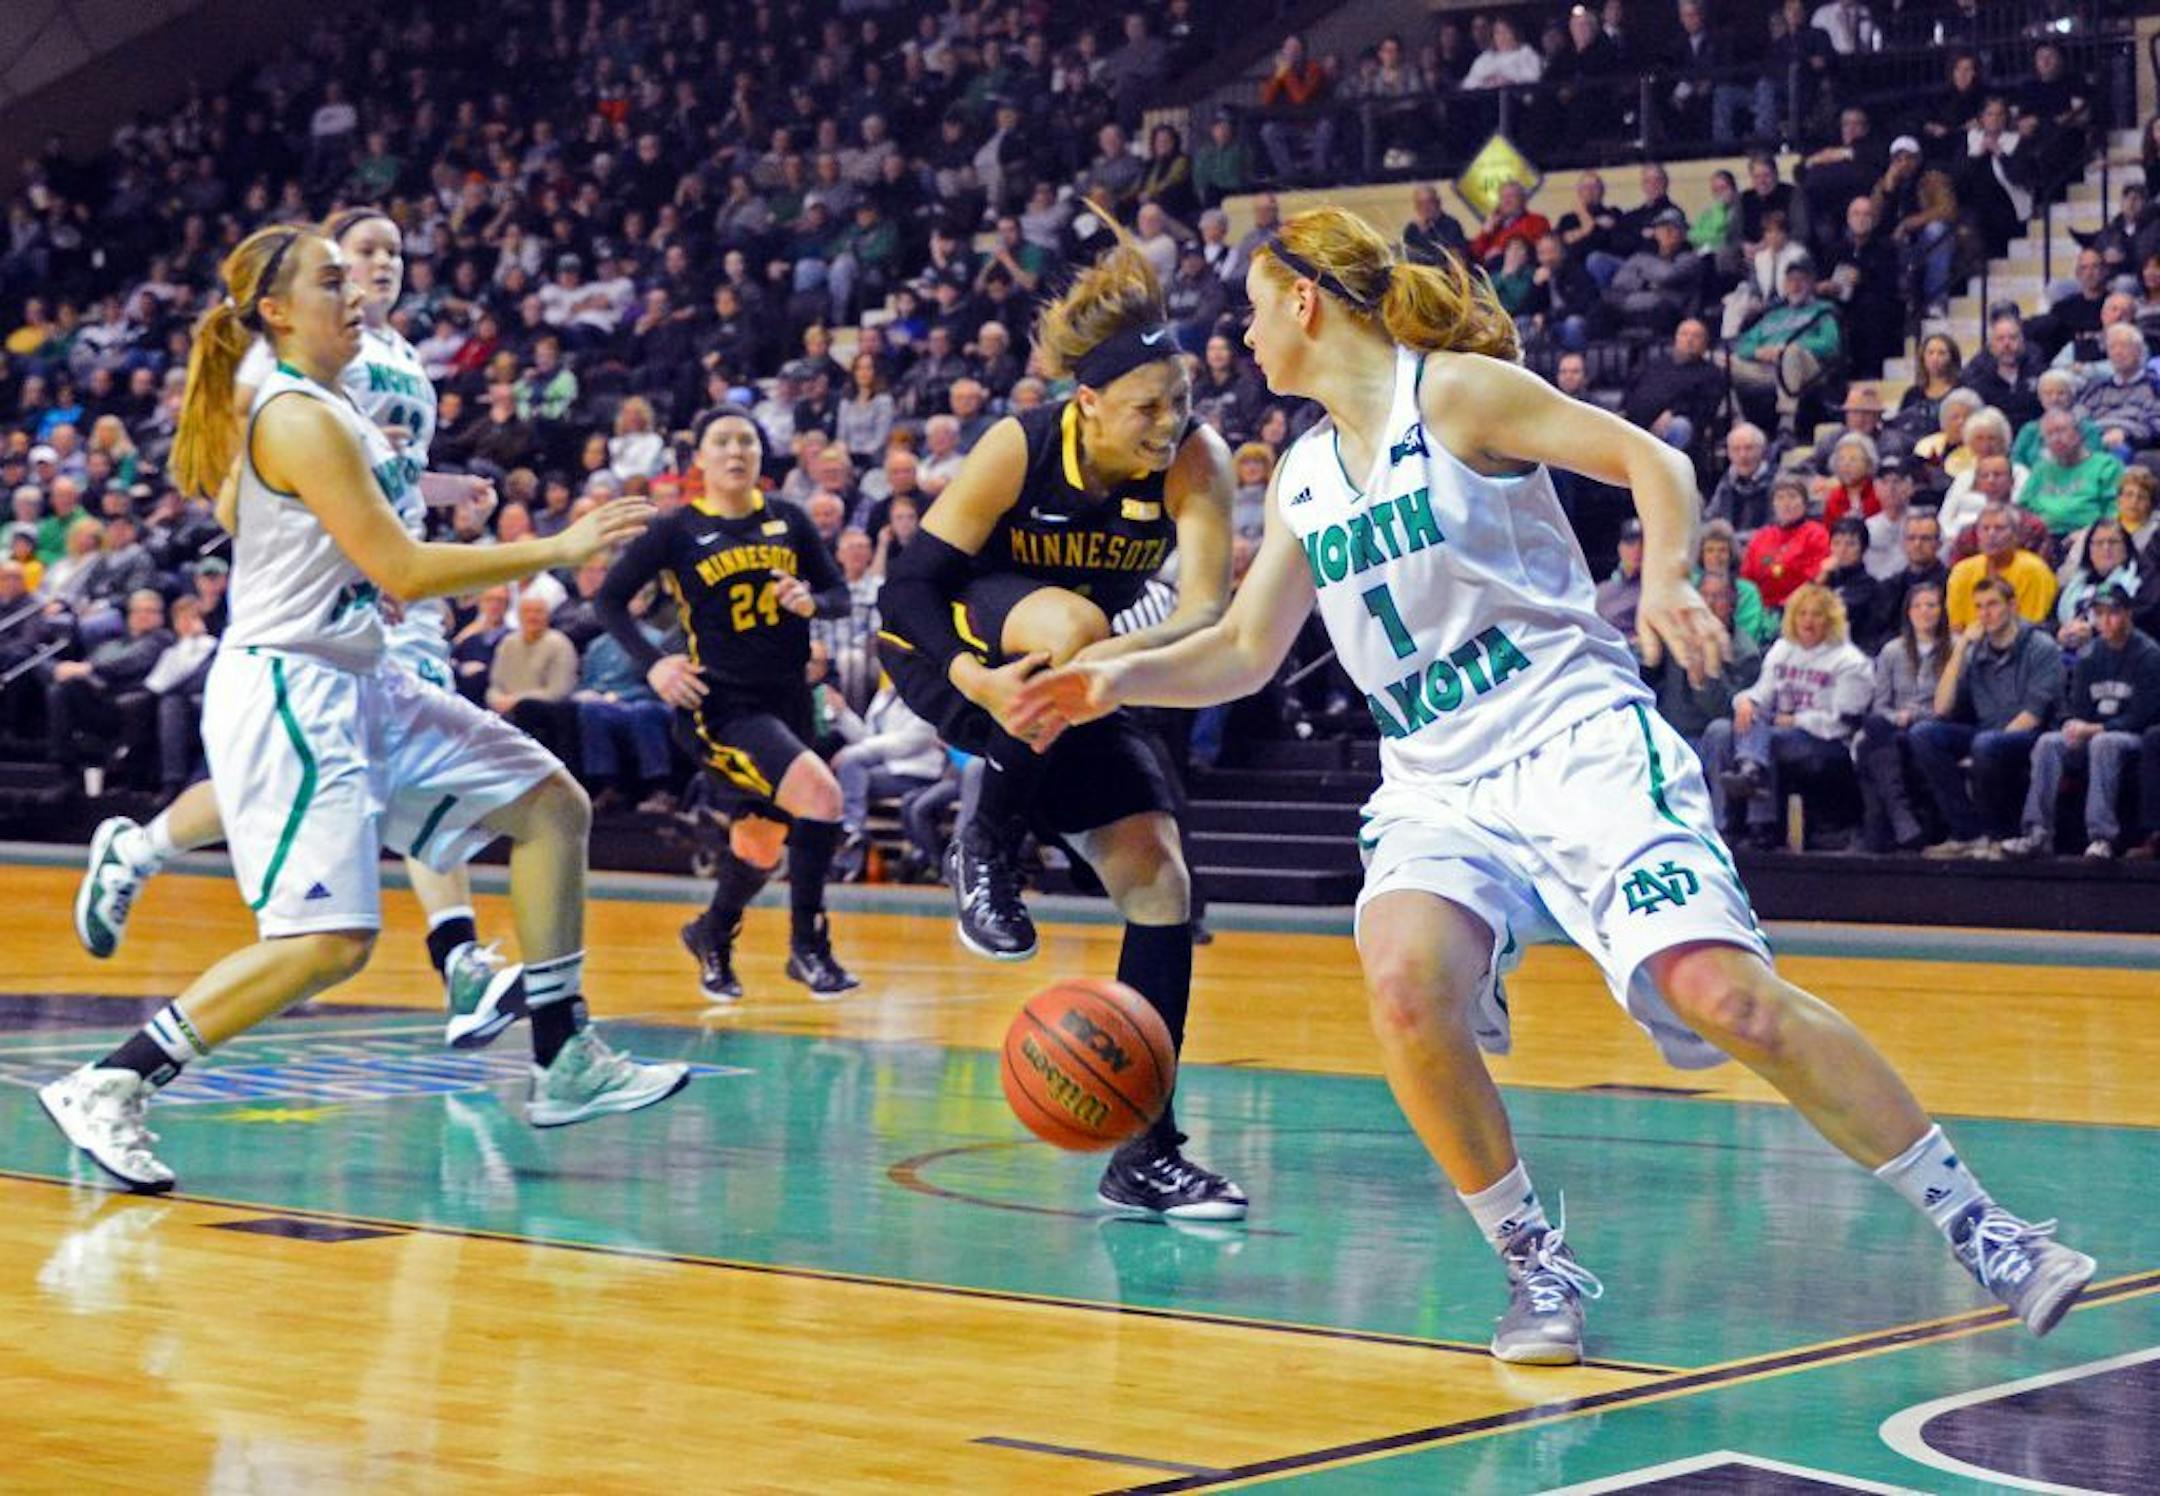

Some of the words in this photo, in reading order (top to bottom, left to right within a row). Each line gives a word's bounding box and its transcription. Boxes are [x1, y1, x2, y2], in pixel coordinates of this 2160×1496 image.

[695, 544, 797, 587] MINNESOTA
[1010, 526, 1168, 572] MINNESOTA
[729, 580, 779, 632] 24
[1362, 583, 1418, 660] 1
[1366, 625, 1532, 739] AKOTA
